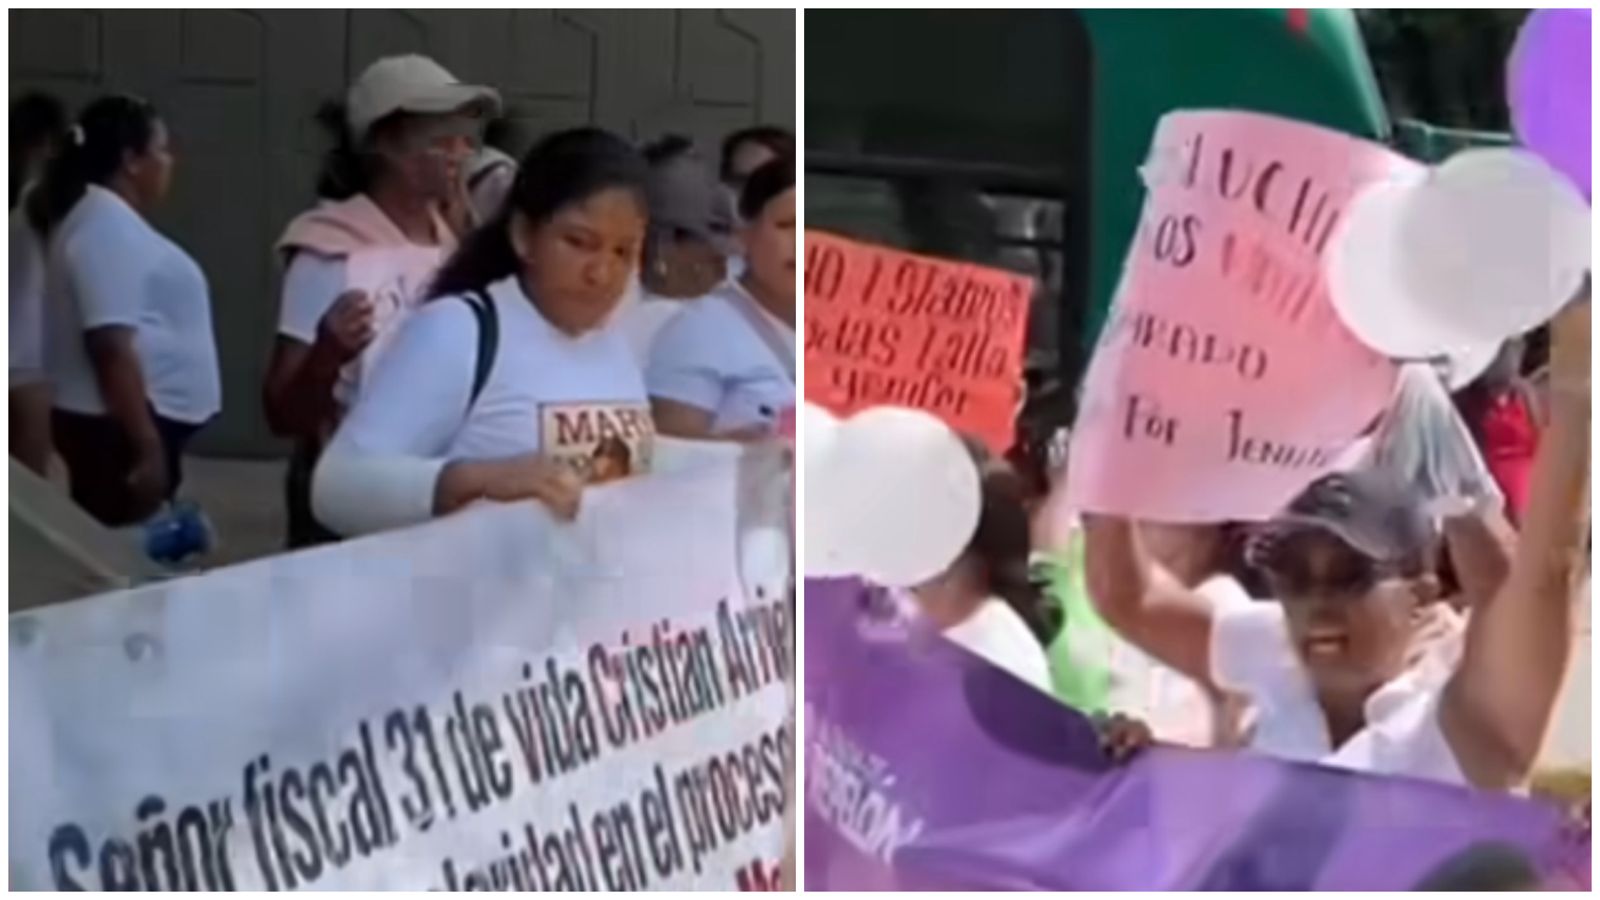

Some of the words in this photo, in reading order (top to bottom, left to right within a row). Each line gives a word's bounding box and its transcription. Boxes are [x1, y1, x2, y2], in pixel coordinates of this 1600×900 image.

[242, 718, 400, 892] fiscal
[384, 703, 458, 832] 31
[445, 689, 513, 813] de
[502, 655, 601, 785] vida
[587, 617, 725, 748] Cristian
[591, 800, 648, 892] en
[640, 762, 685, 878] el
